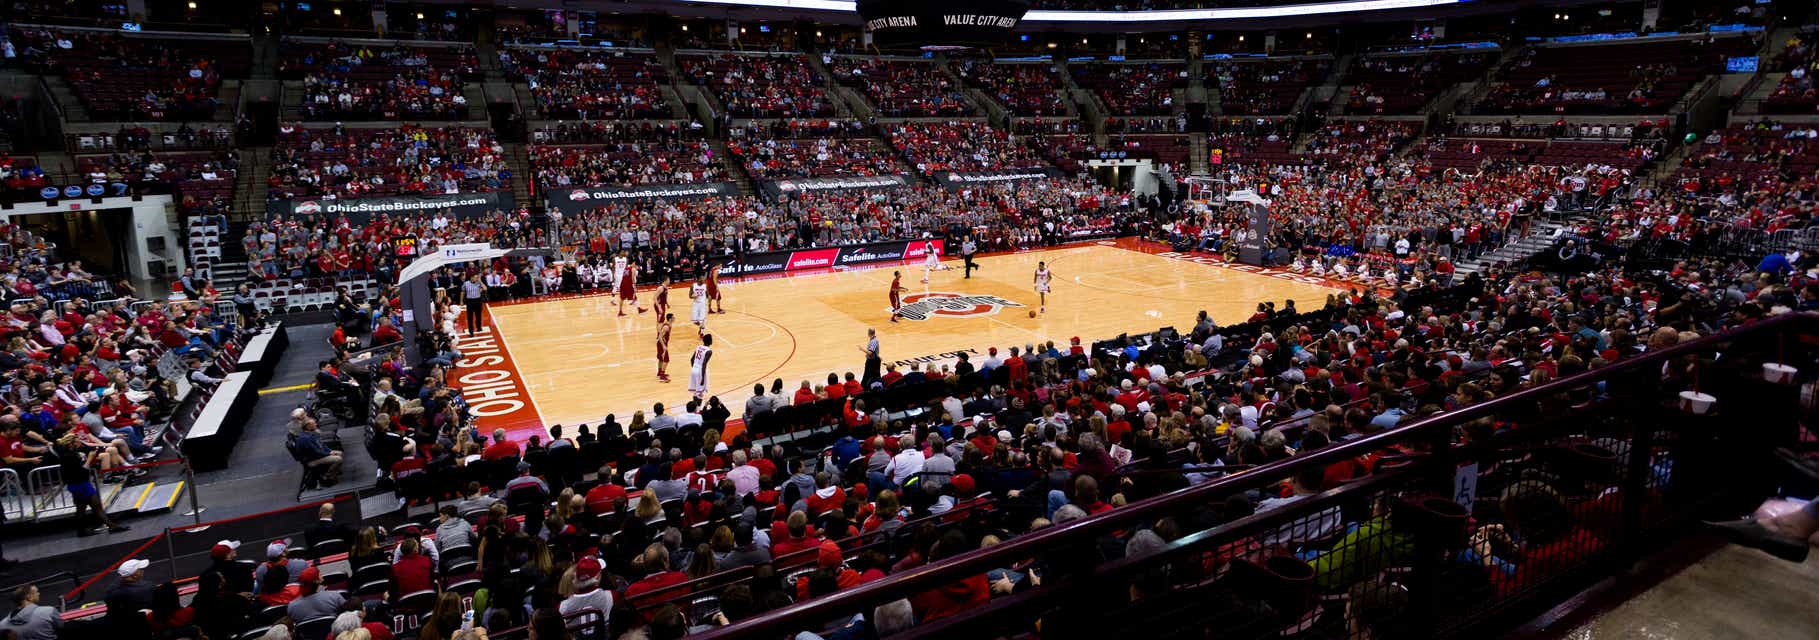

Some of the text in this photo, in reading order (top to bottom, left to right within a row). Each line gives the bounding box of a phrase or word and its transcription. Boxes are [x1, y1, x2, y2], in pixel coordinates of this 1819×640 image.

[888, 15, 918, 27] ARENA
[943, 14, 976, 25] VALUE
[977, 15, 999, 26] CITY
[593, 186, 718, 200] OhioStateBuckeyes.com
[326, 197, 487, 213] OhioStateBuckeyes.com
[793, 258, 829, 267] safelite.com
[842, 252, 876, 263] Safelite
[882, 354, 942, 368] ALUE
[456, 326, 525, 417] OHIO STATE
